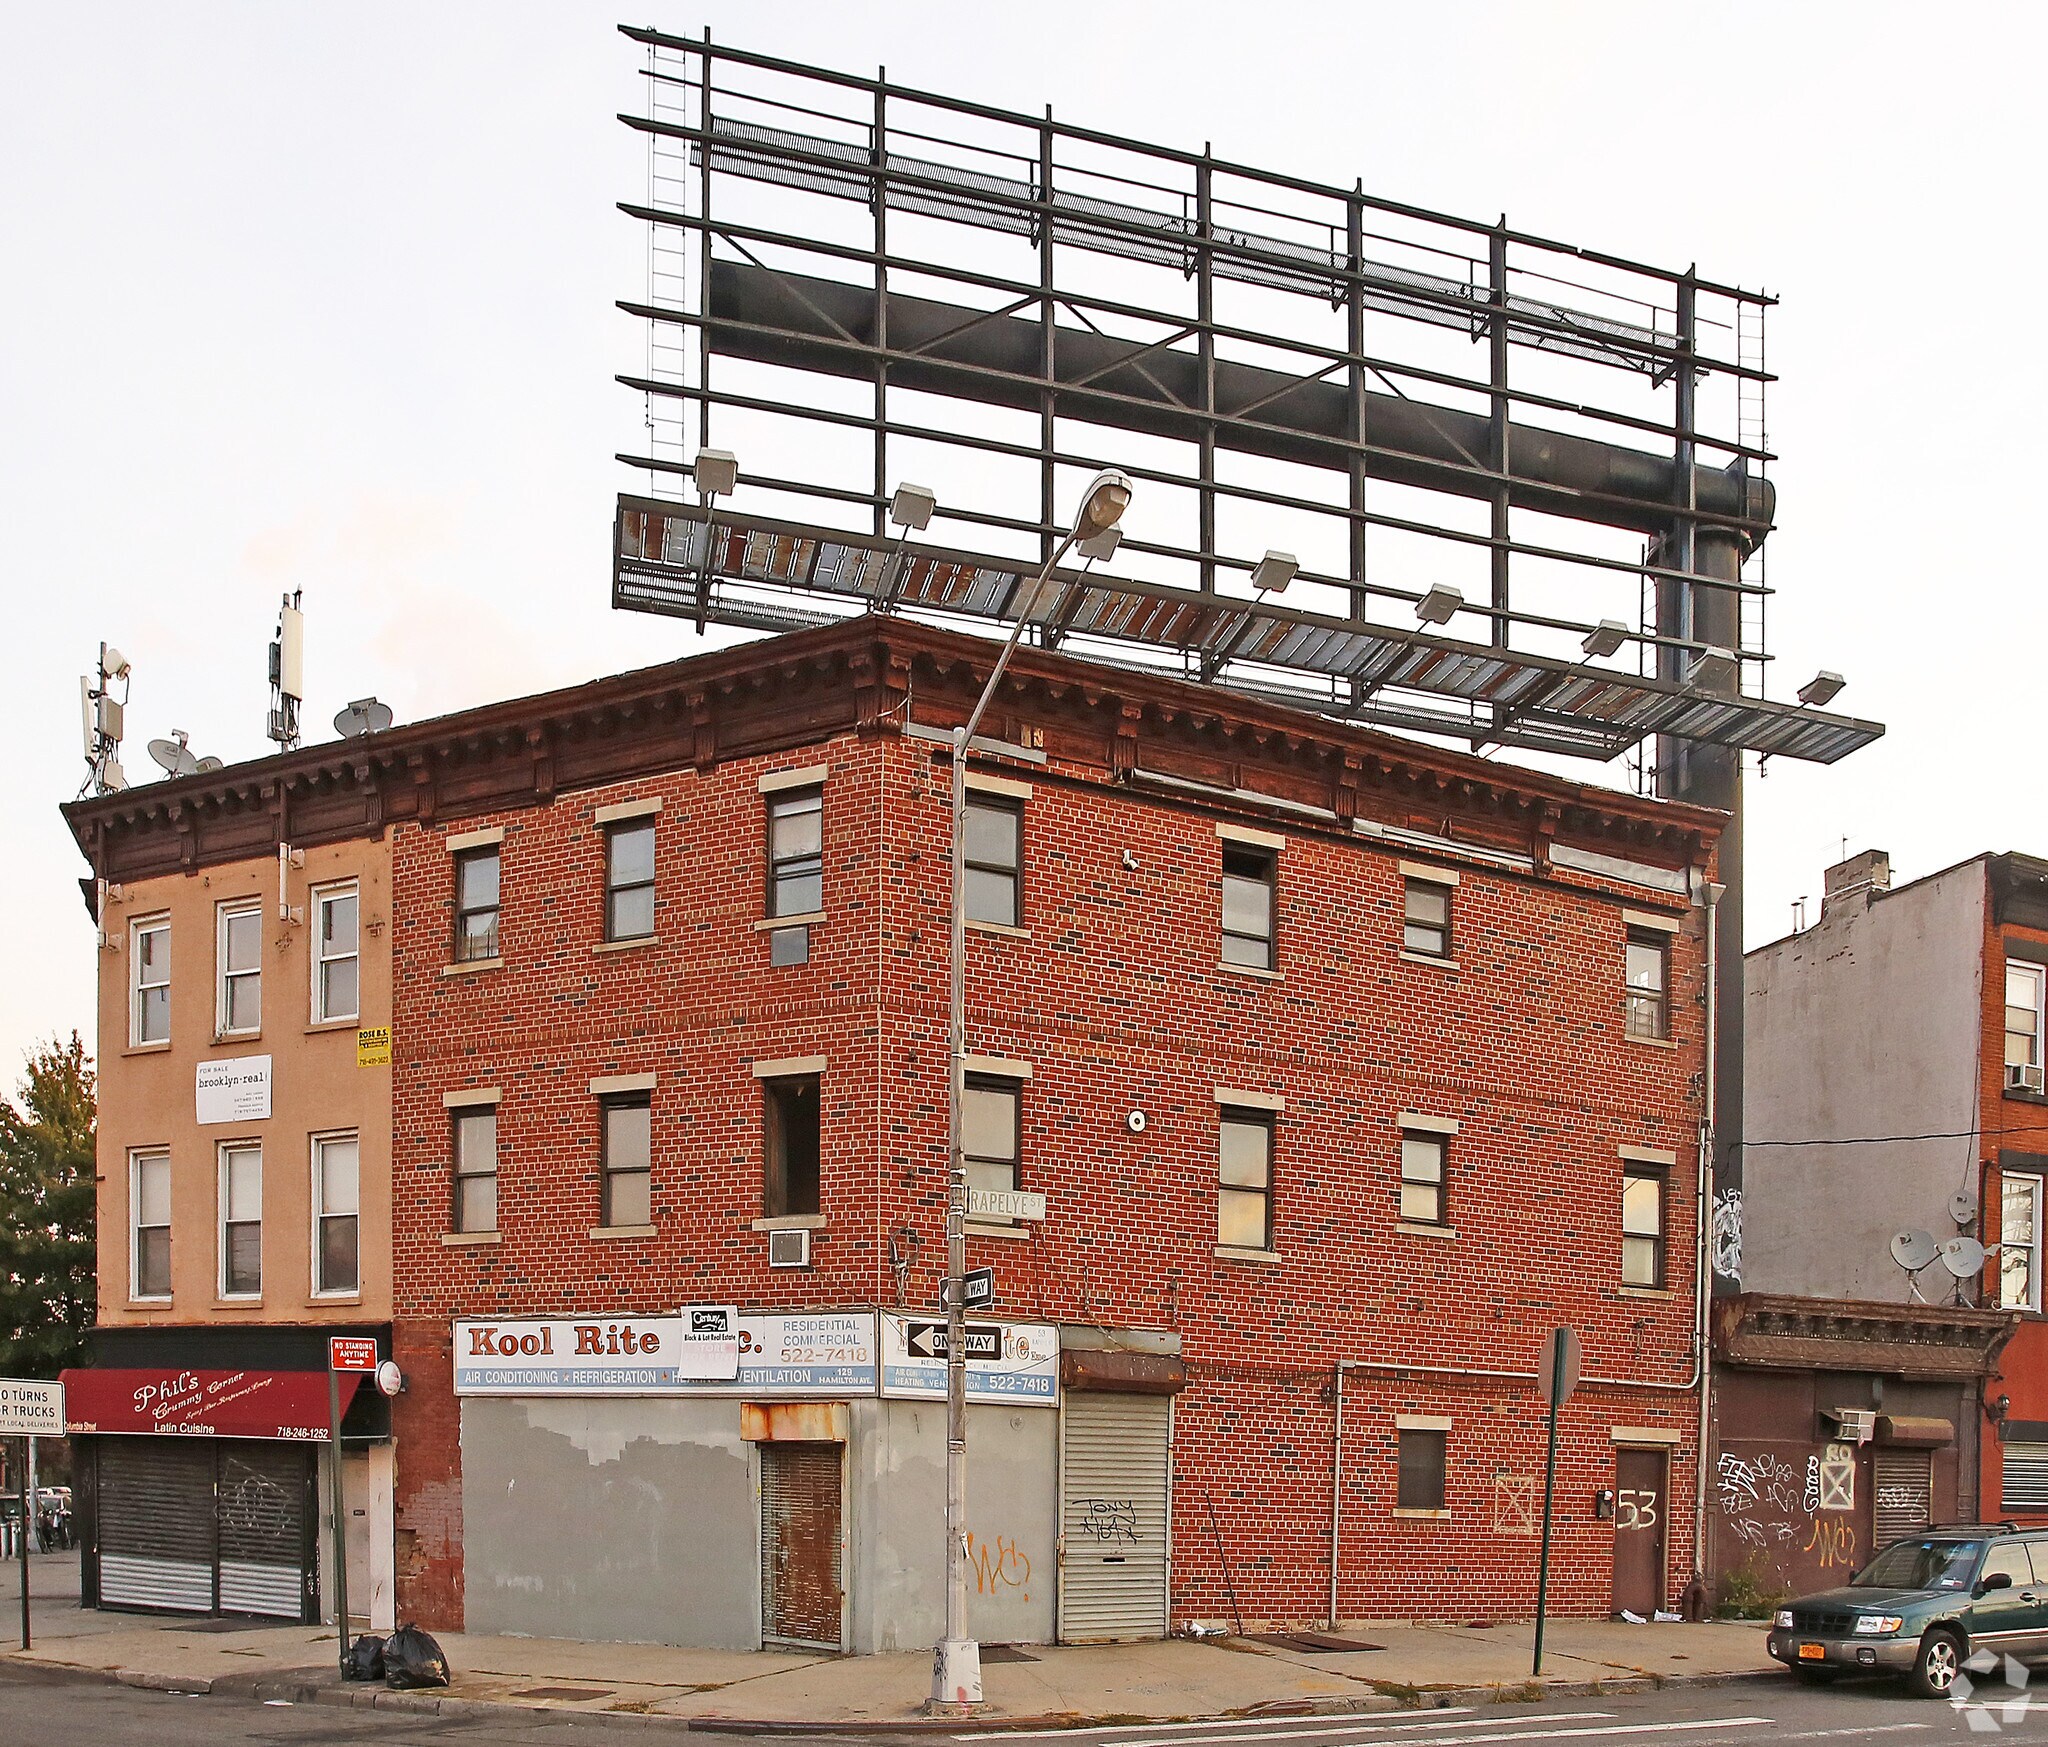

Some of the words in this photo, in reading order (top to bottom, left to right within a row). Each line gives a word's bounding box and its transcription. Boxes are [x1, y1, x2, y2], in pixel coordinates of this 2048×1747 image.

[359, 1030, 375, 1039] ROSE
[213, 1065, 228, 1073] SALE
[970, 1190, 1028, 1216] RAPELYE
[1029, 1196, 1042, 1208] ST
[969, 1280, 986, 1297] WAY
[693, 1311, 721, 1325] Century
[717, 1318, 727, 1331] 21
[783, 1320, 860, 1331] RESIDENTIAL
[467, 1325, 554, 1357] Kool
[573, 1324, 660, 1356] Rite
[738, 1330, 763, 1355] c.
[684, 1333, 697, 1341] Block
[702, 1333, 710, 1341] Lot
[711, 1333, 721, 1341] Real
[722, 1333, 736, 1341] Estate
[783, 1334, 861, 1346] COMMERCIAL
[932, 1334, 949, 1348] ON
[965, 1335, 992, 1350] WAY
[334, 1342, 344, 1350] NO
[345, 1342, 373, 1351] STANDING
[1003, 1328, 1030, 1360] te
[339, 1350, 370, 1358] ANYTIME
[781, 1347, 867, 1362] 522-7418
[465, 1370, 481, 1384] AIR
[485, 1370, 559, 1384] CONDITIONING
[572, 1369, 657, 1384] REFRIGERATION
[737, 1369, 811, 1384] VENTILATION
[837, 1368, 853, 1376] 129
[206, 1371, 245, 1394] Corner
[819, 1376, 859, 1384] HAMILTON
[895, 1377, 925, 1387] HEATING
[989, 1375, 1050, 1393] 522-7418
[12, 1390, 48, 1403] TURNS
[133, 1370, 199, 1412] Phil's
[13, 1405, 56, 1418] TRUCKS
[27, 1421, 59, 1429] DELIVERIES
[154, 1421, 177, 1434] Latin
[179, 1422, 215, 1435] Cuisine
[277, 1426, 329, 1439] 718-246-1252
[1617, 1489, 1657, 1530] 53
